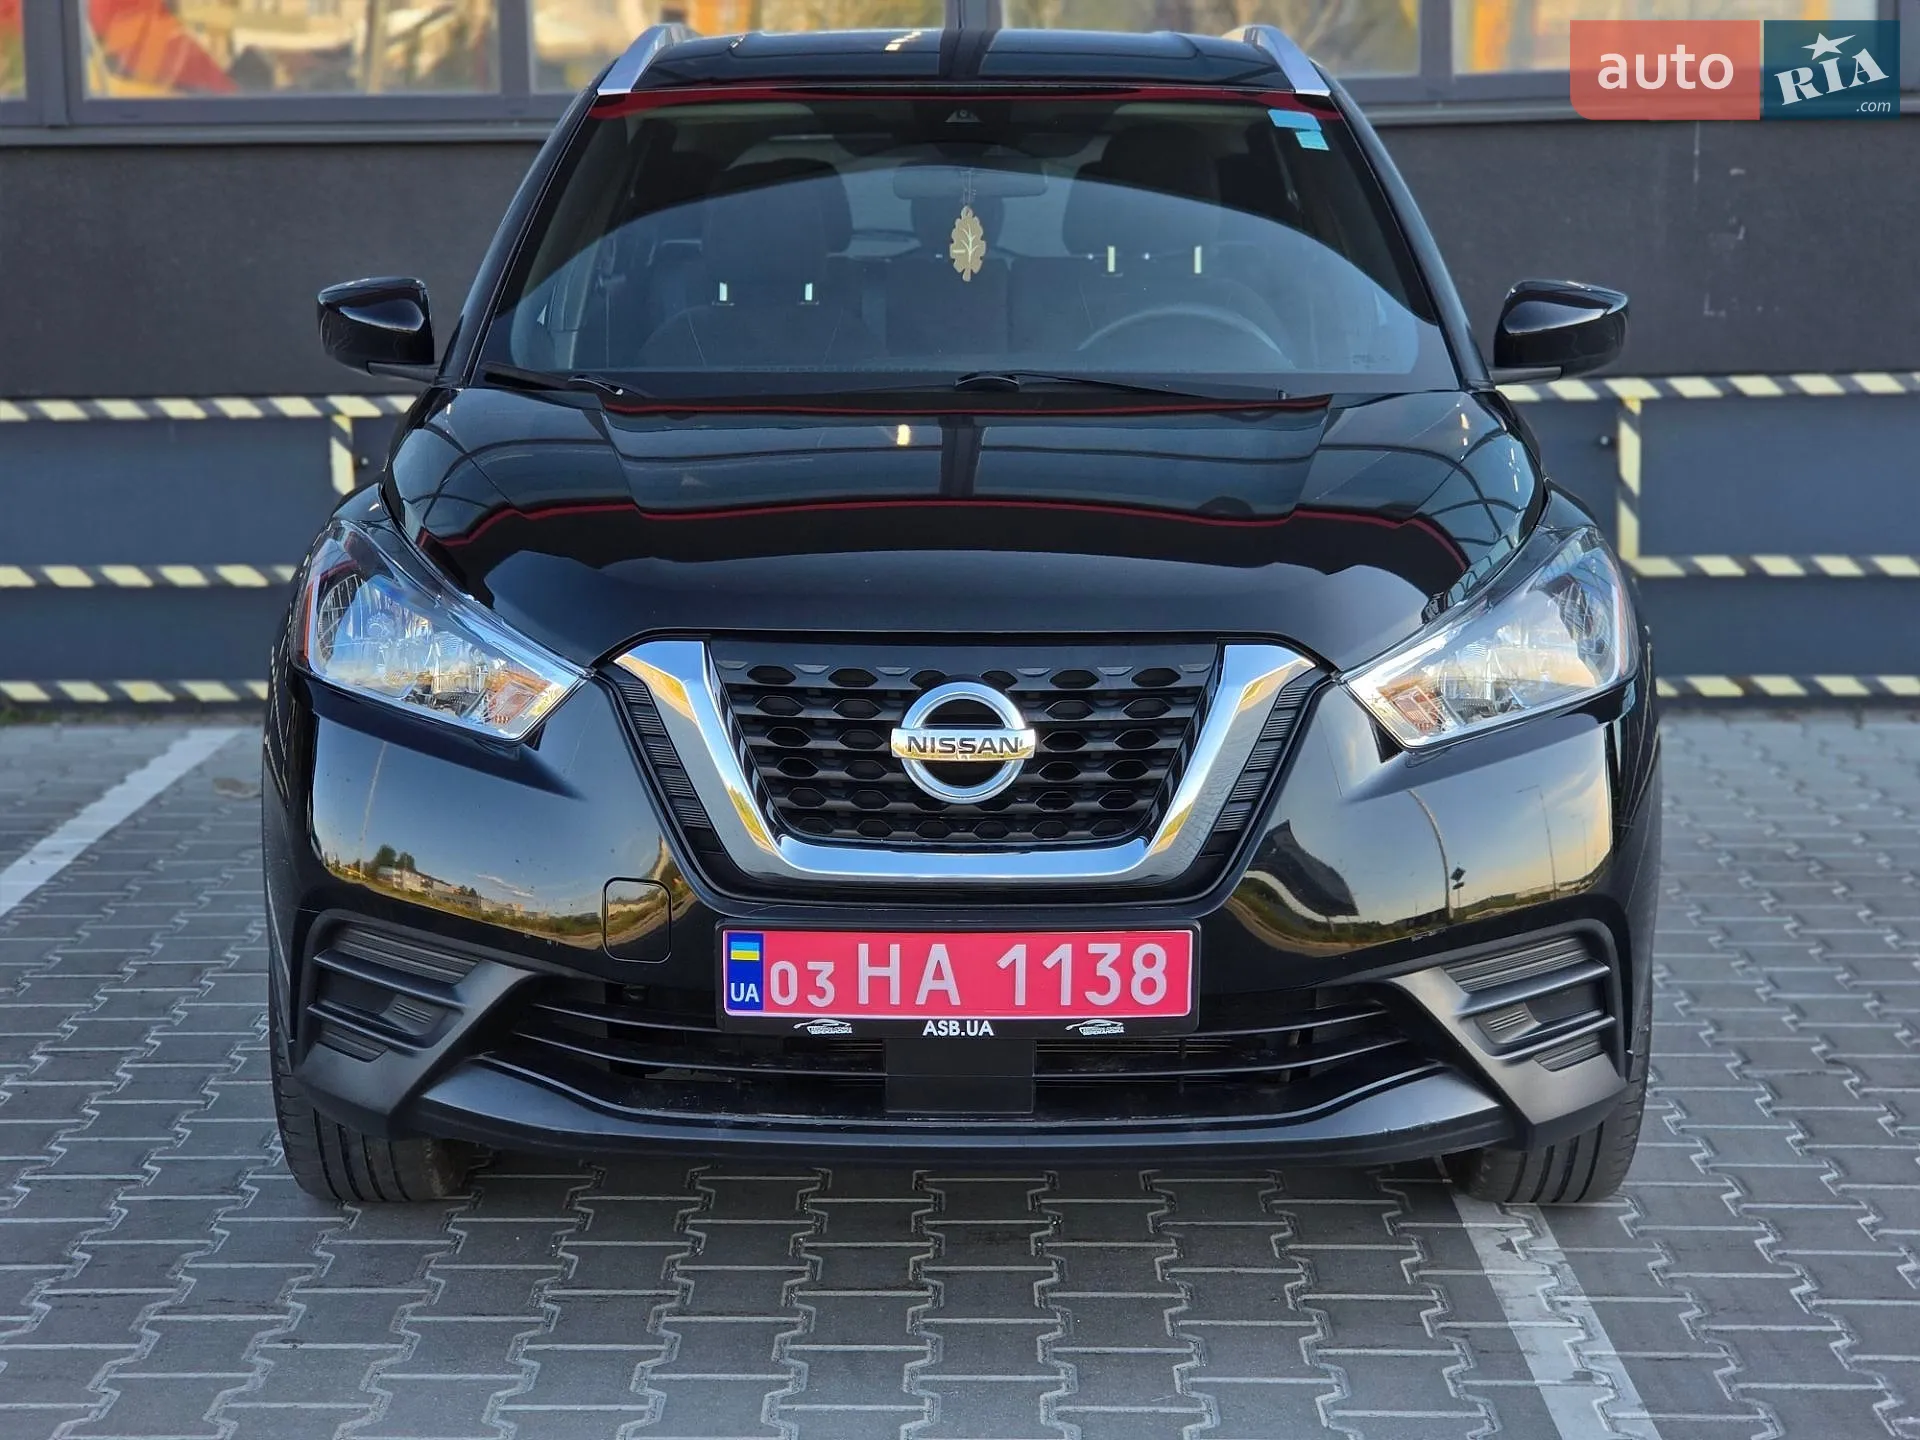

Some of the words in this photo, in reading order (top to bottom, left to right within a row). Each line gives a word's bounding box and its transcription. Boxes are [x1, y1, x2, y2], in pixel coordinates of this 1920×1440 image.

[907, 735, 1020, 755] NISSAN
[769, 960, 836, 1008] 03
[857, 943, 962, 1007] HA
[996, 942, 1168, 1007] 1138
[730, 982, 760, 1004] UA
[922, 1019, 995, 1038] ASB.UA
